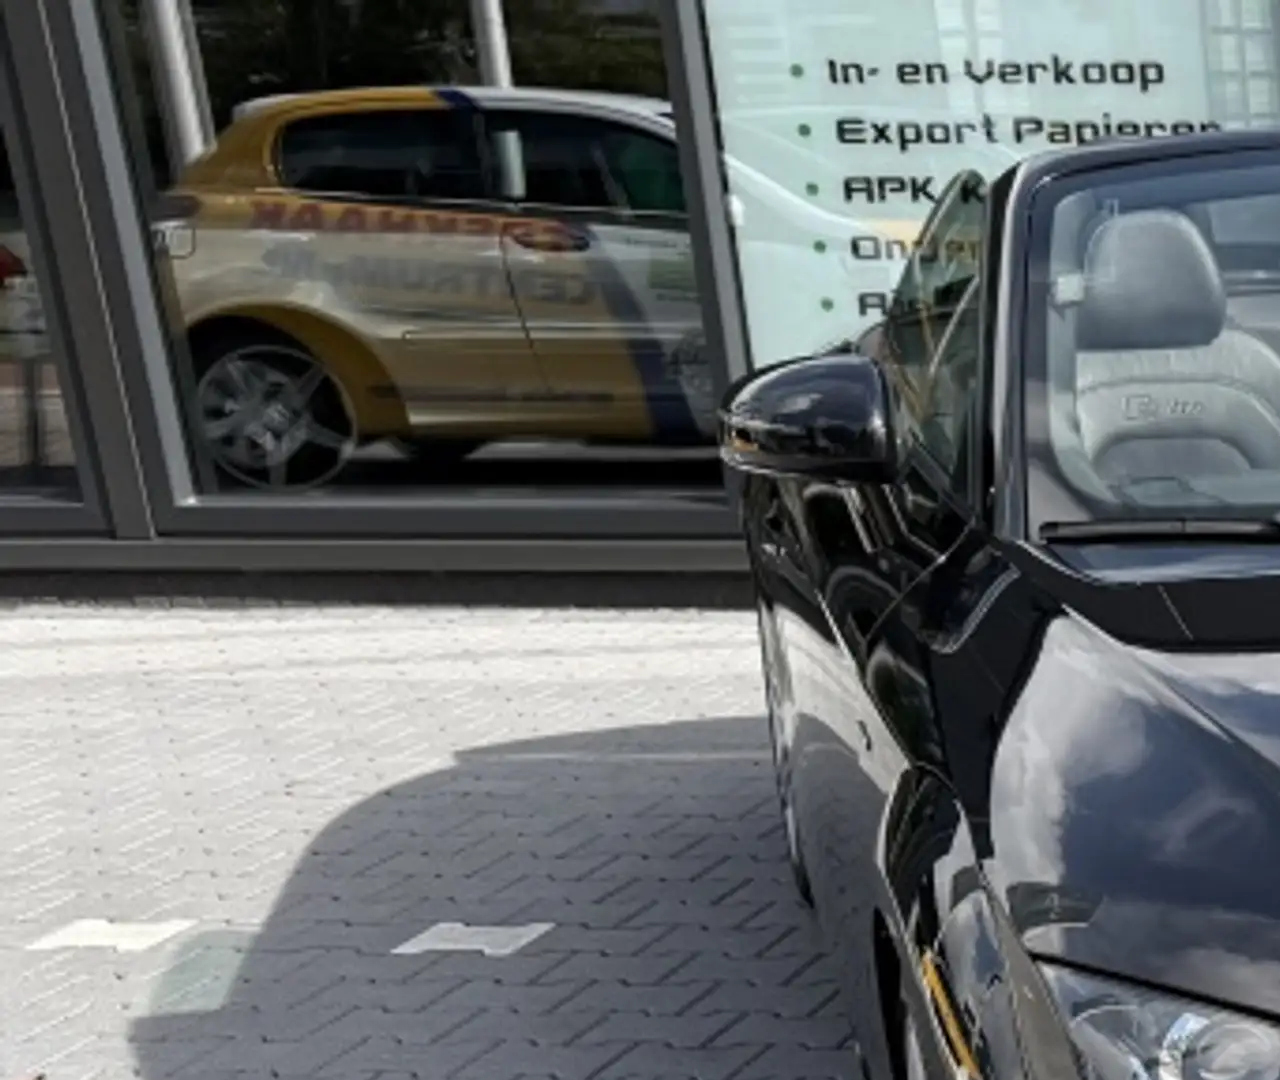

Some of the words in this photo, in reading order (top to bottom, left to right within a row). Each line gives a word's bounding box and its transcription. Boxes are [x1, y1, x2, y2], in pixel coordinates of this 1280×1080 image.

[827, 58, 880, 85] In-
[897, 60, 949, 85] en
[963, 53, 1165, 93] Verkoop
[835, 112, 1000, 151] Export
[843, 175, 937, 204] APK
